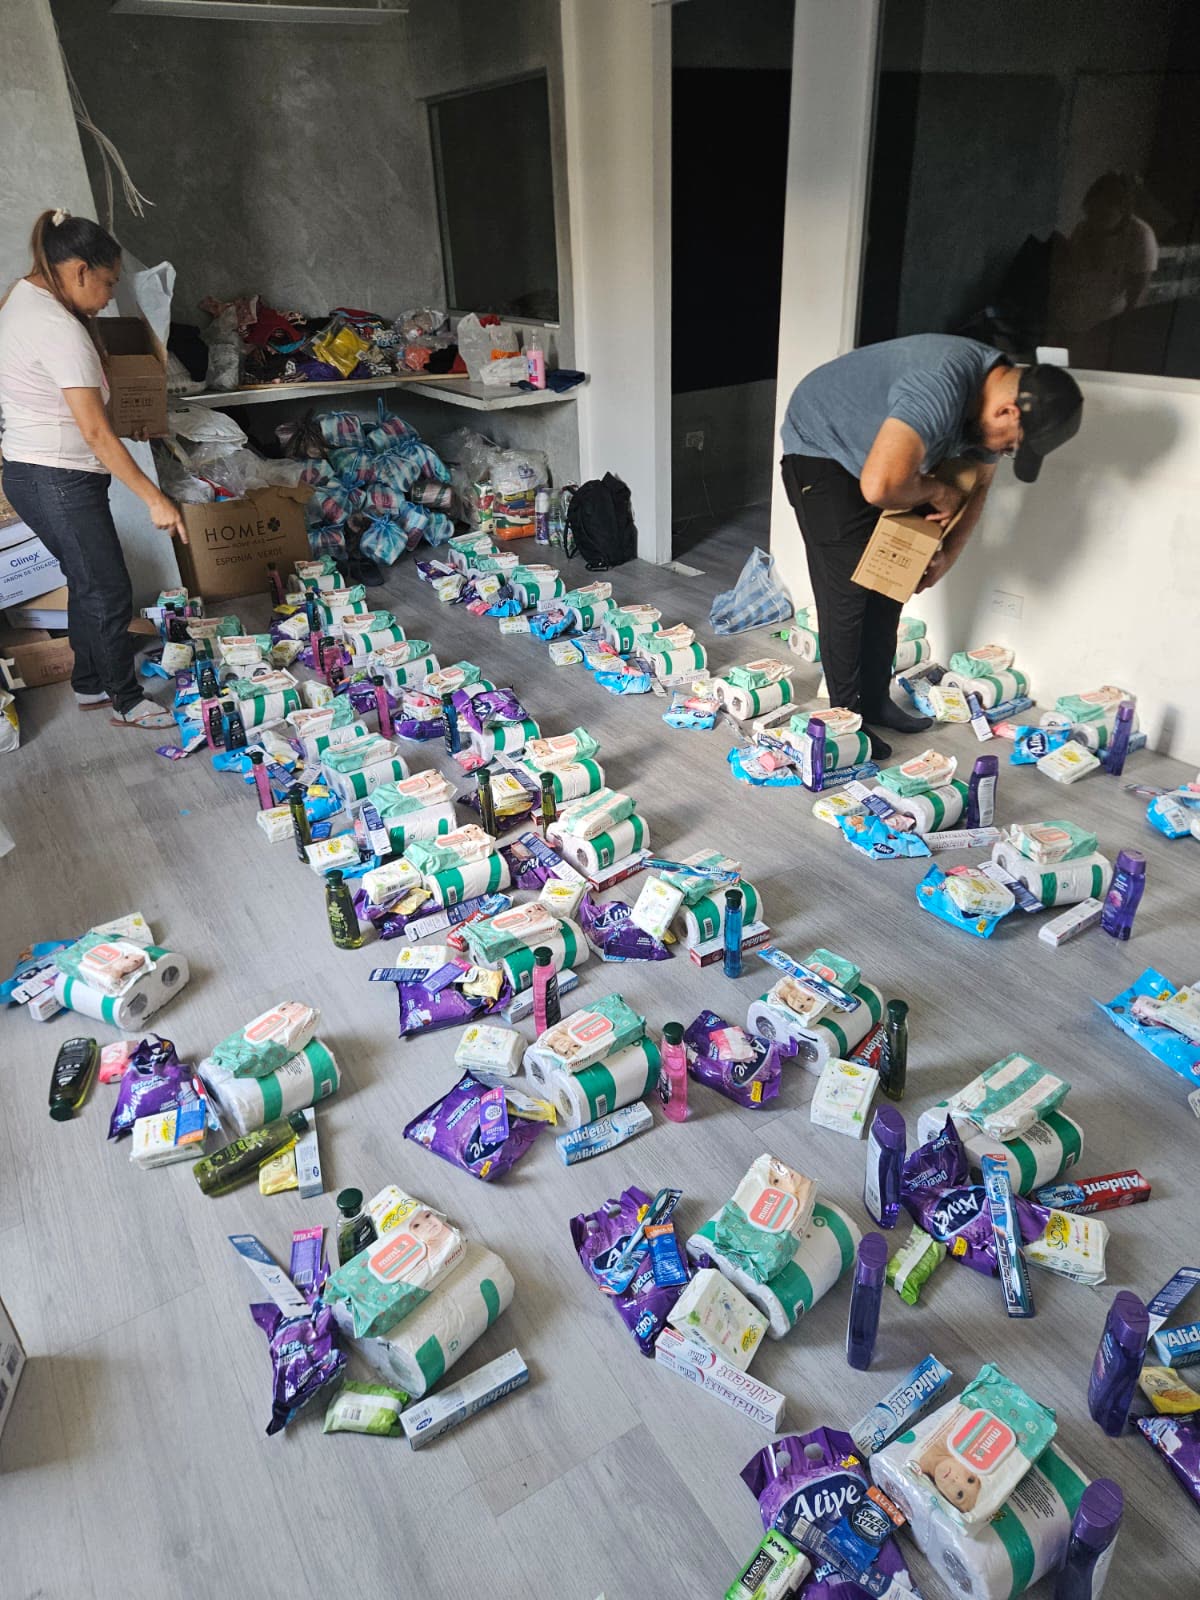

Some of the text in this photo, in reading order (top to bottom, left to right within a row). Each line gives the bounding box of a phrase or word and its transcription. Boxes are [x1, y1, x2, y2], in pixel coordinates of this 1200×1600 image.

[204, 520, 266, 543] HOME
[10, 551, 40, 568] Clinex
[600, 905, 633, 927] Aliv
[563, 1117, 611, 1146] Alident
[1082, 1174, 1140, 1196] Alident
[377, 1241, 410, 1268] mimlot
[630, 1268, 655, 1295] Deter
[715, 1363, 777, 1405] Alident
[892, 1363, 942, 1419] Alident
[704, 1377, 775, 1425] Alident
[975, 1426, 1004, 1463] mimlot
[793, 1483, 861, 1523] Alive
[854, 1517, 883, 1537] STICK
[859, 1508, 889, 1530] SPEED
[742, 1551, 769, 1586] EVISSA
